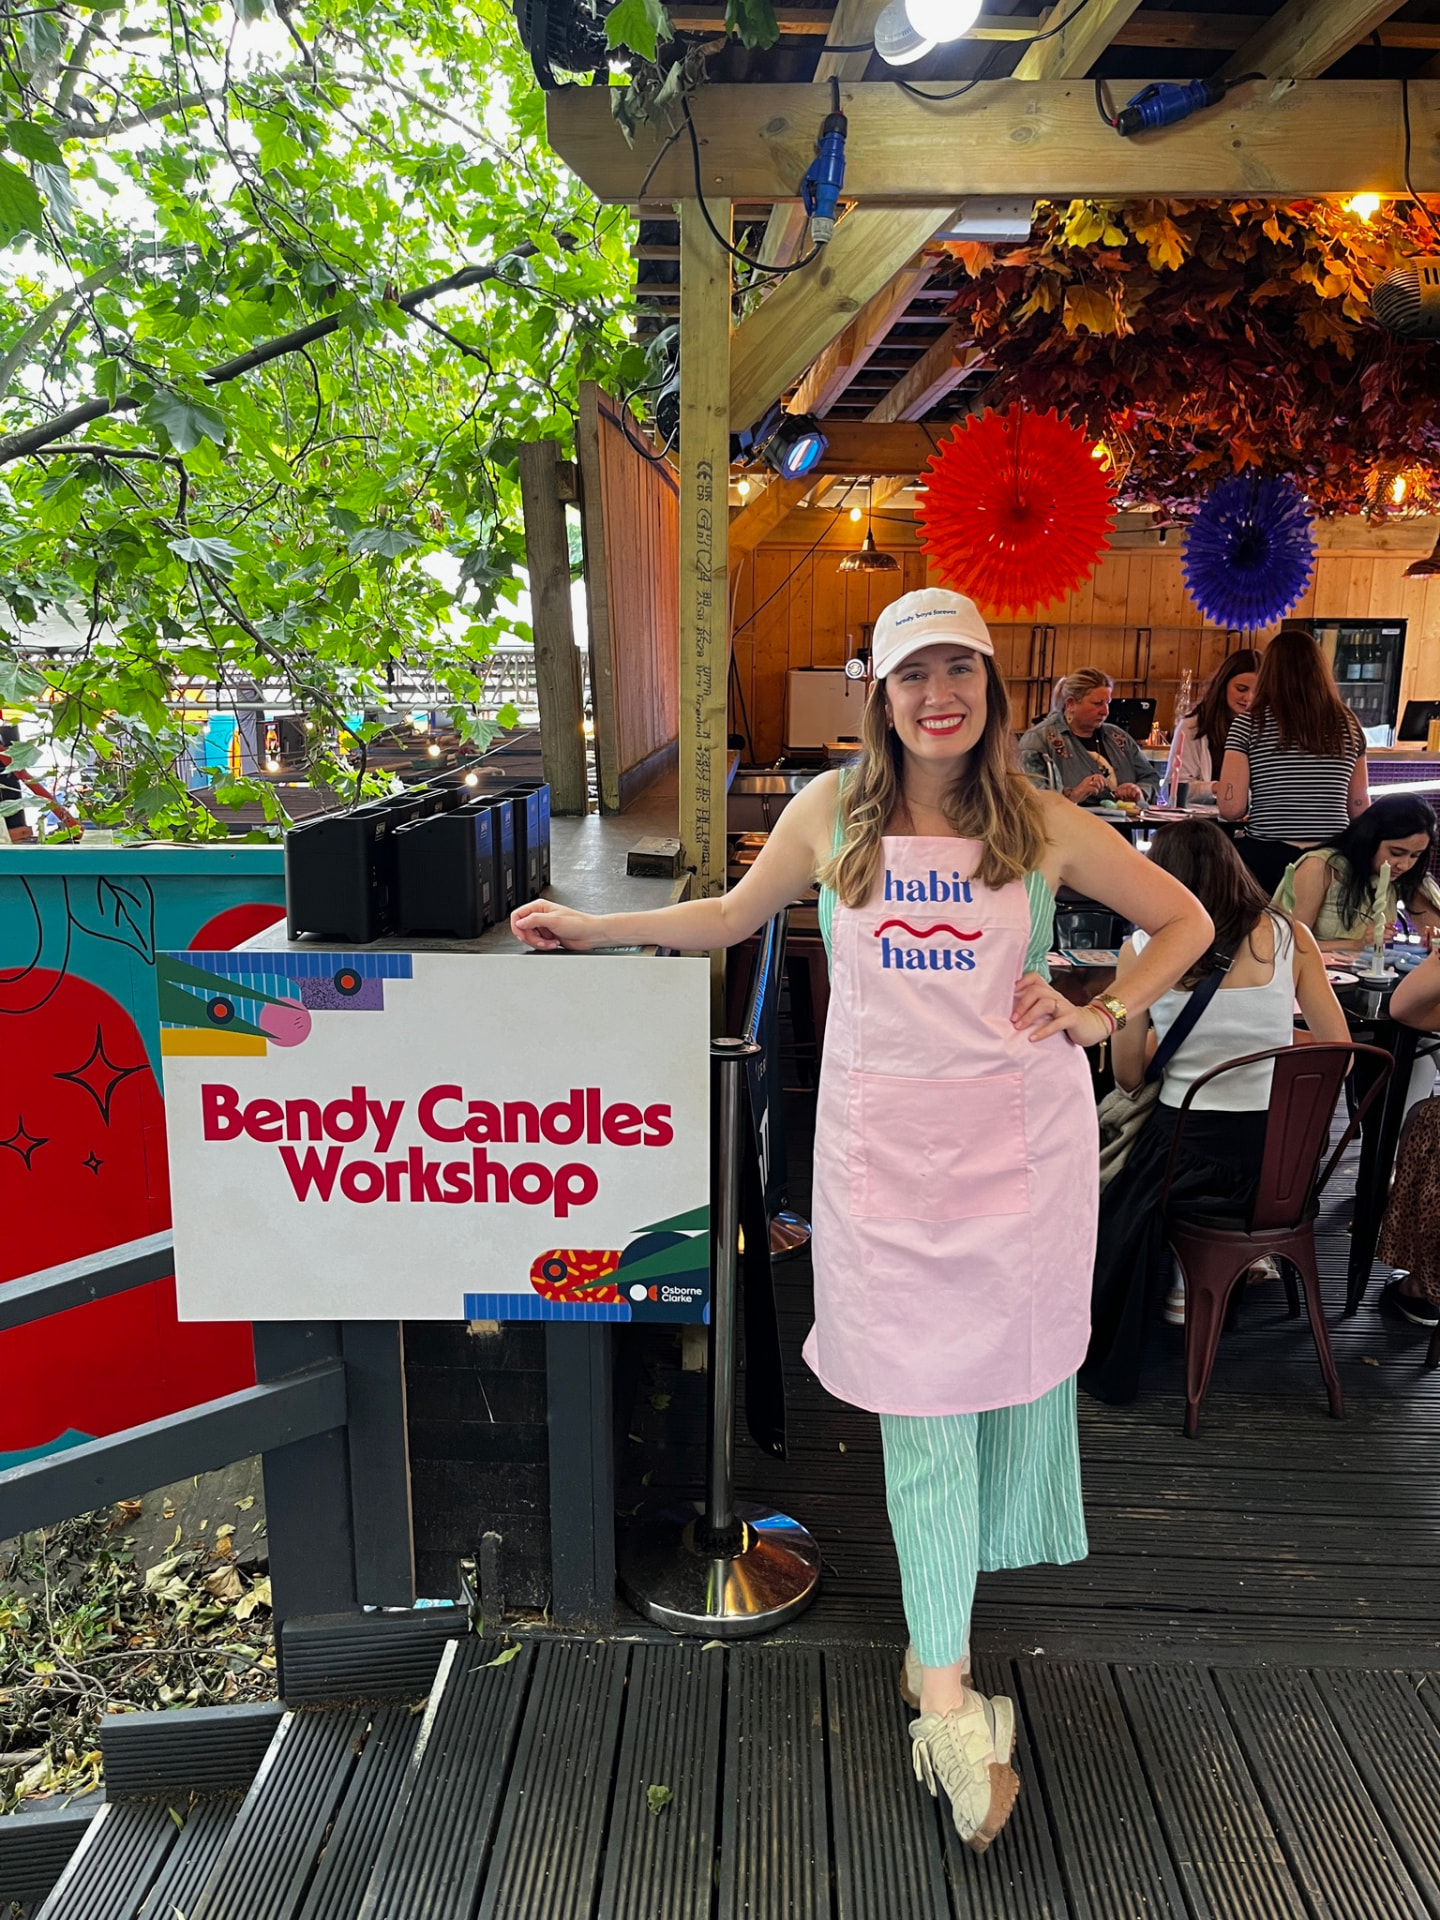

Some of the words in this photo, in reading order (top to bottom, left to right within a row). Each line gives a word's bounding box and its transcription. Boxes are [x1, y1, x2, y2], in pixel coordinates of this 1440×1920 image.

[884, 870, 973, 903] habit
[882, 937, 976, 971] haus
[201, 1083, 405, 1152] Bendy
[418, 1084, 674, 1147] Candles
[278, 1145, 599, 1218] Workshop
[661, 1285, 702, 1295] Osborne
[661, 1294, 692, 1303] Clarke
